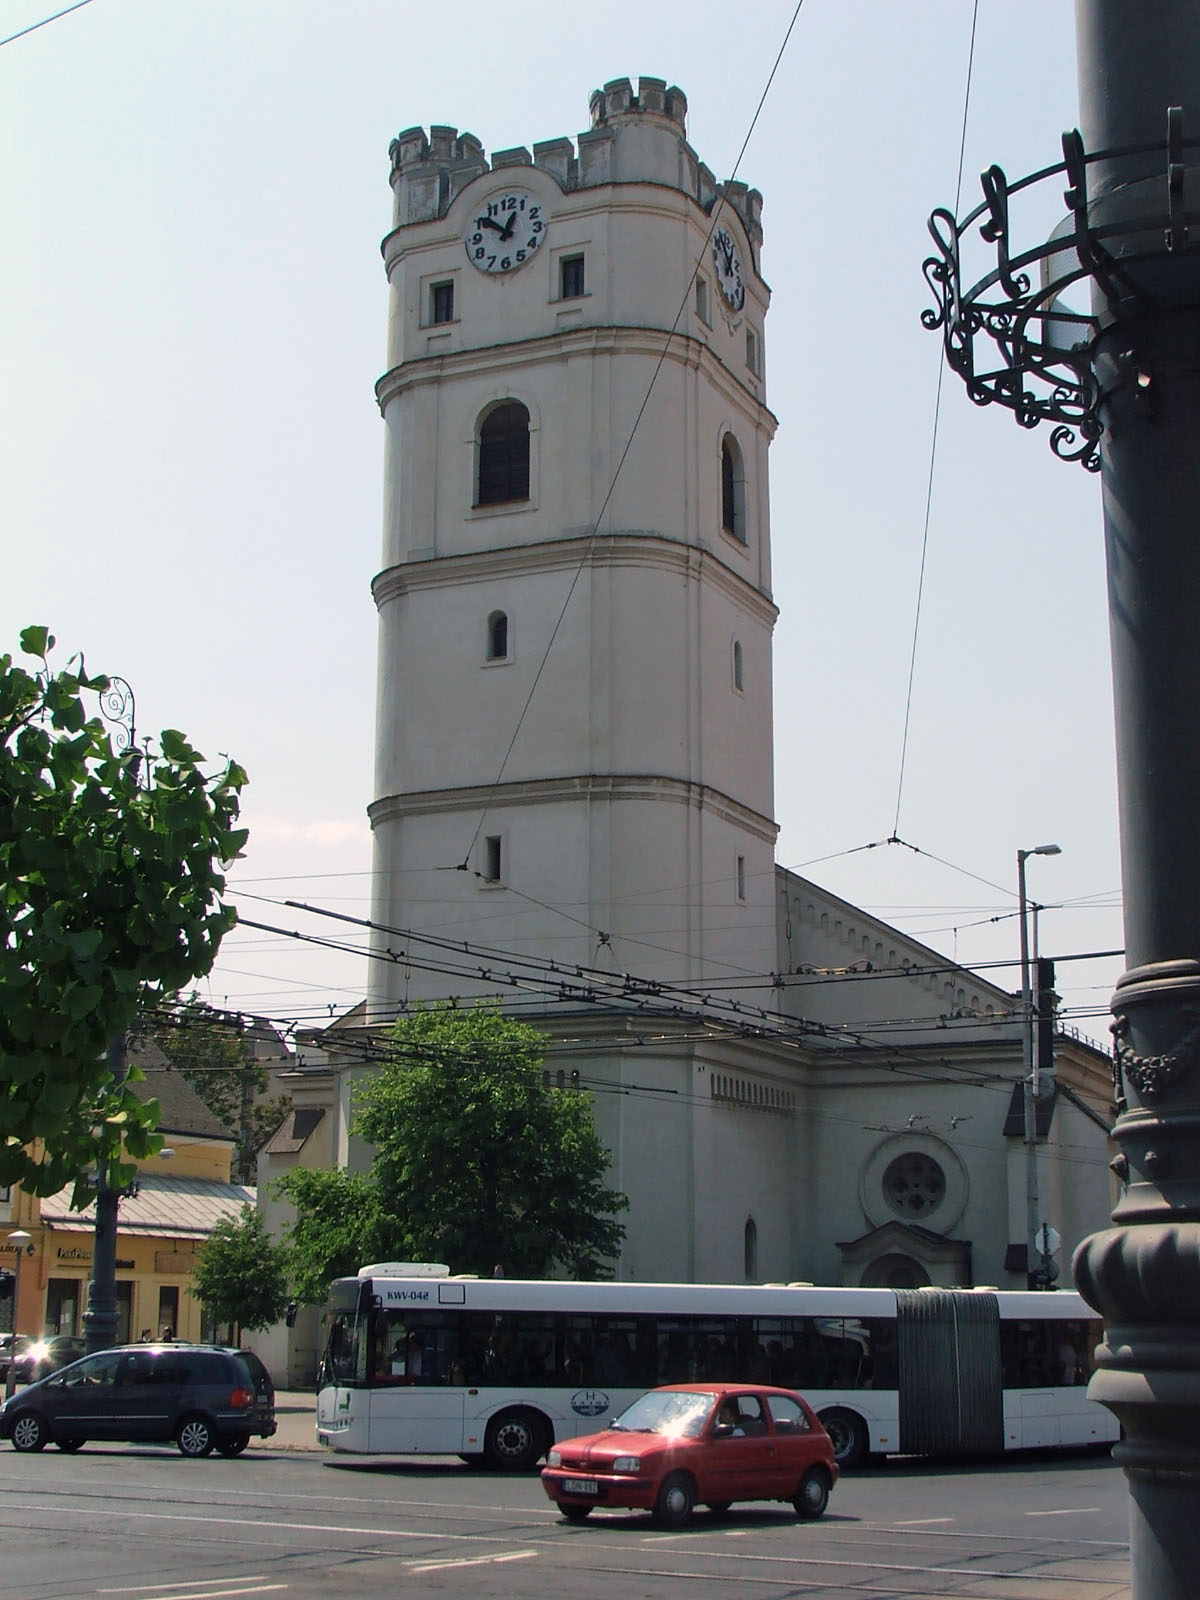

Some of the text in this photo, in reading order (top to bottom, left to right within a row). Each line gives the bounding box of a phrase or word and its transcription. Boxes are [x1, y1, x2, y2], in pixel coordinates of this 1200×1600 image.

[487, 204, 498, 216] 11
[501, 197, 517, 211] 12
[520, 199, 525, 211] 1
[529, 207, 539, 220] 2
[533, 221, 542, 233] 3
[472, 233, 482, 245] 9
[527, 236, 537, 249] 4
[475, 247, 485, 259] 8
[516, 249, 526, 262] 5
[487, 255, 497, 268] 7
[501, 257, 511, 269] 6
[387, 1291, 429, 1300] KWV-042
